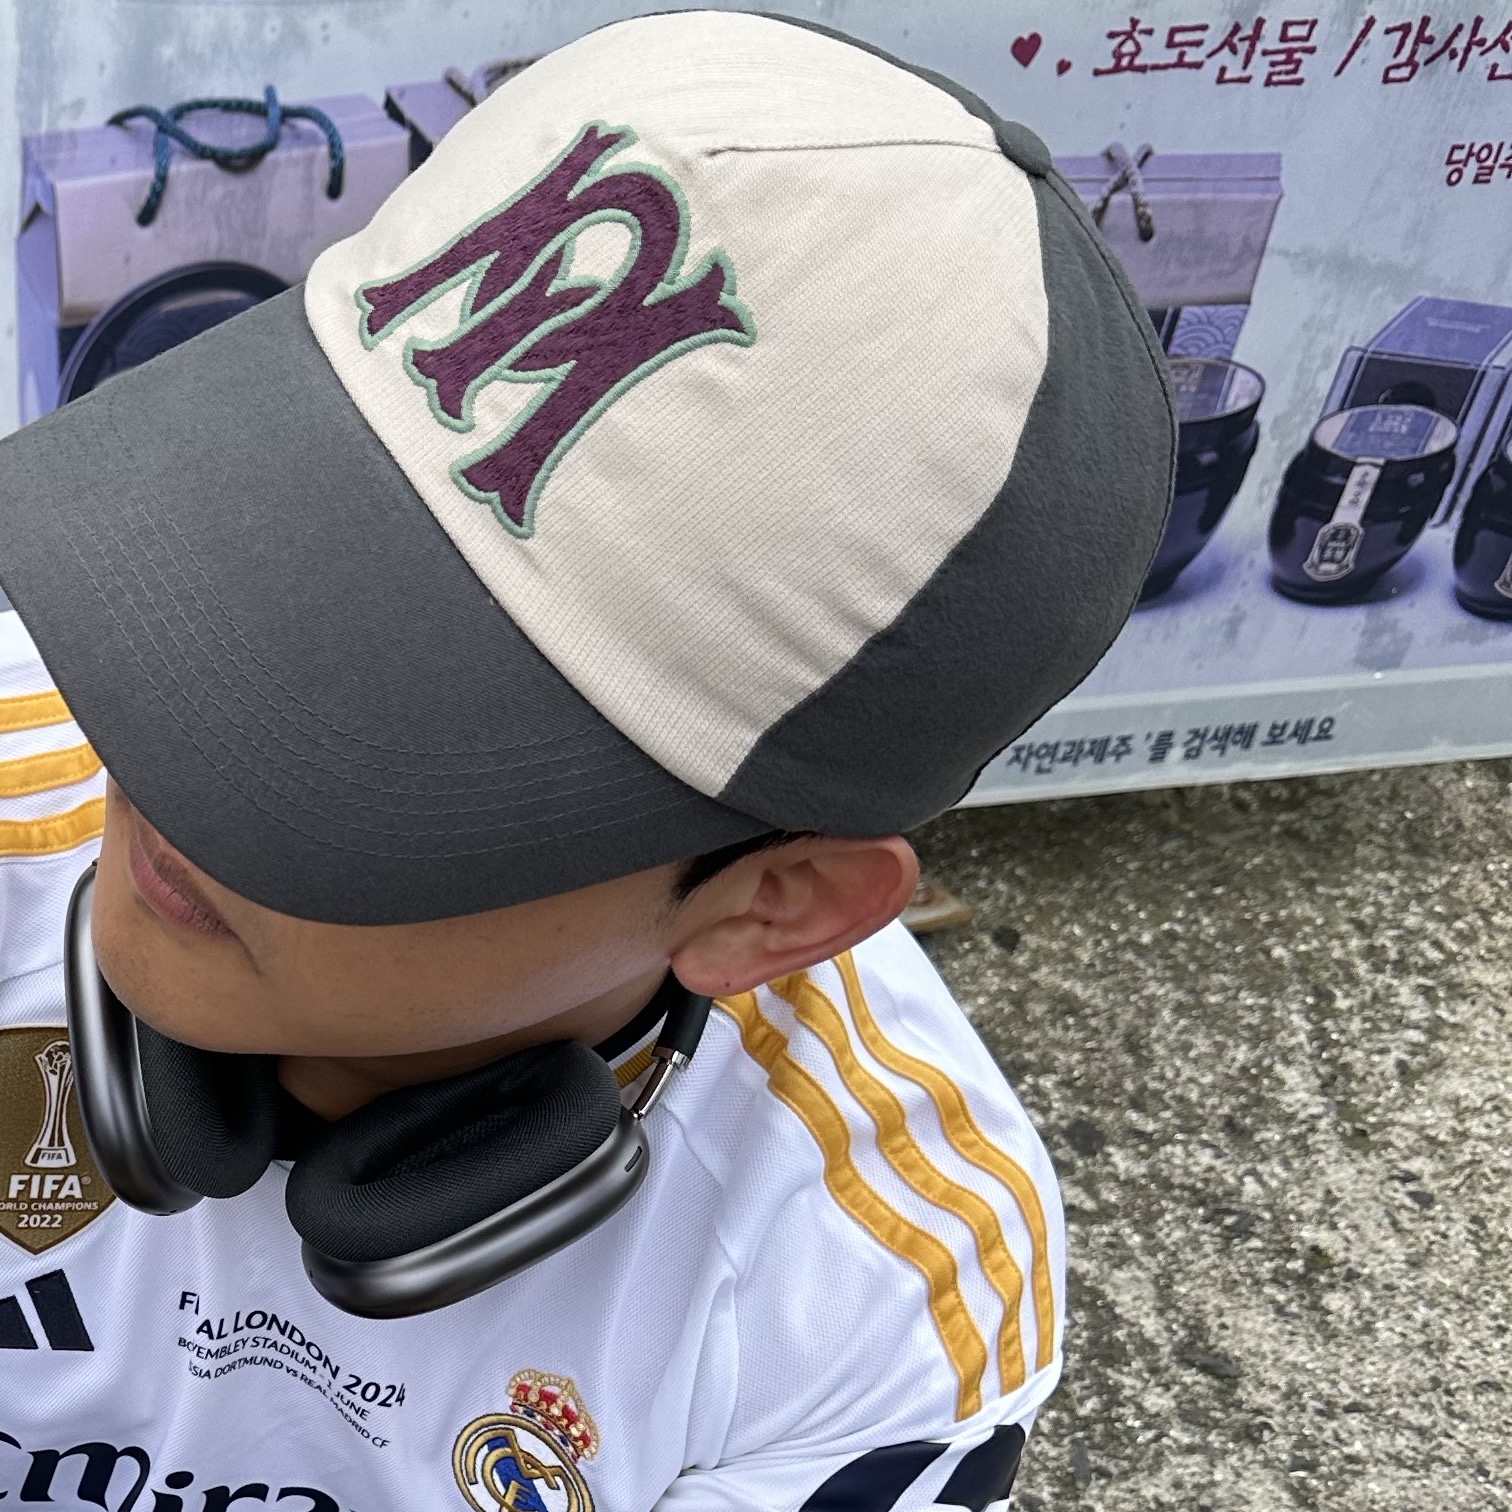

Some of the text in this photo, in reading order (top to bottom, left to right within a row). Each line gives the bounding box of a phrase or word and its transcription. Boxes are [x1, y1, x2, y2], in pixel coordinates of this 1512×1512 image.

[1092, 16, 1318, 87] 효도선물
[1006, 733, 1134, 775] 자연과제주
[1183, 720, 1259, 760] 검색해
[1261, 715, 1336, 745] 보세요
[41, 1152, 63, 1160] FIFA
[8, 1174, 83, 1199] FIFA
[30, 1201, 99, 1211] CHAMPIONS
[17, 1214, 63, 1228] 2022
[178, 1290, 406, 1409] FIAL LONDON 2024
[191, 1336, 250, 1361] EMBLEY
[250, 1336, 318, 1375] STADIUM
[334, 1391, 370, 1422] JUNE
[214, 1355, 284, 1379] DORTMUND
[300, 1373, 328, 1399] REAL
[329, 1396, 370, 1440] MADRID
[371, 1436, 391, 1449] CF
